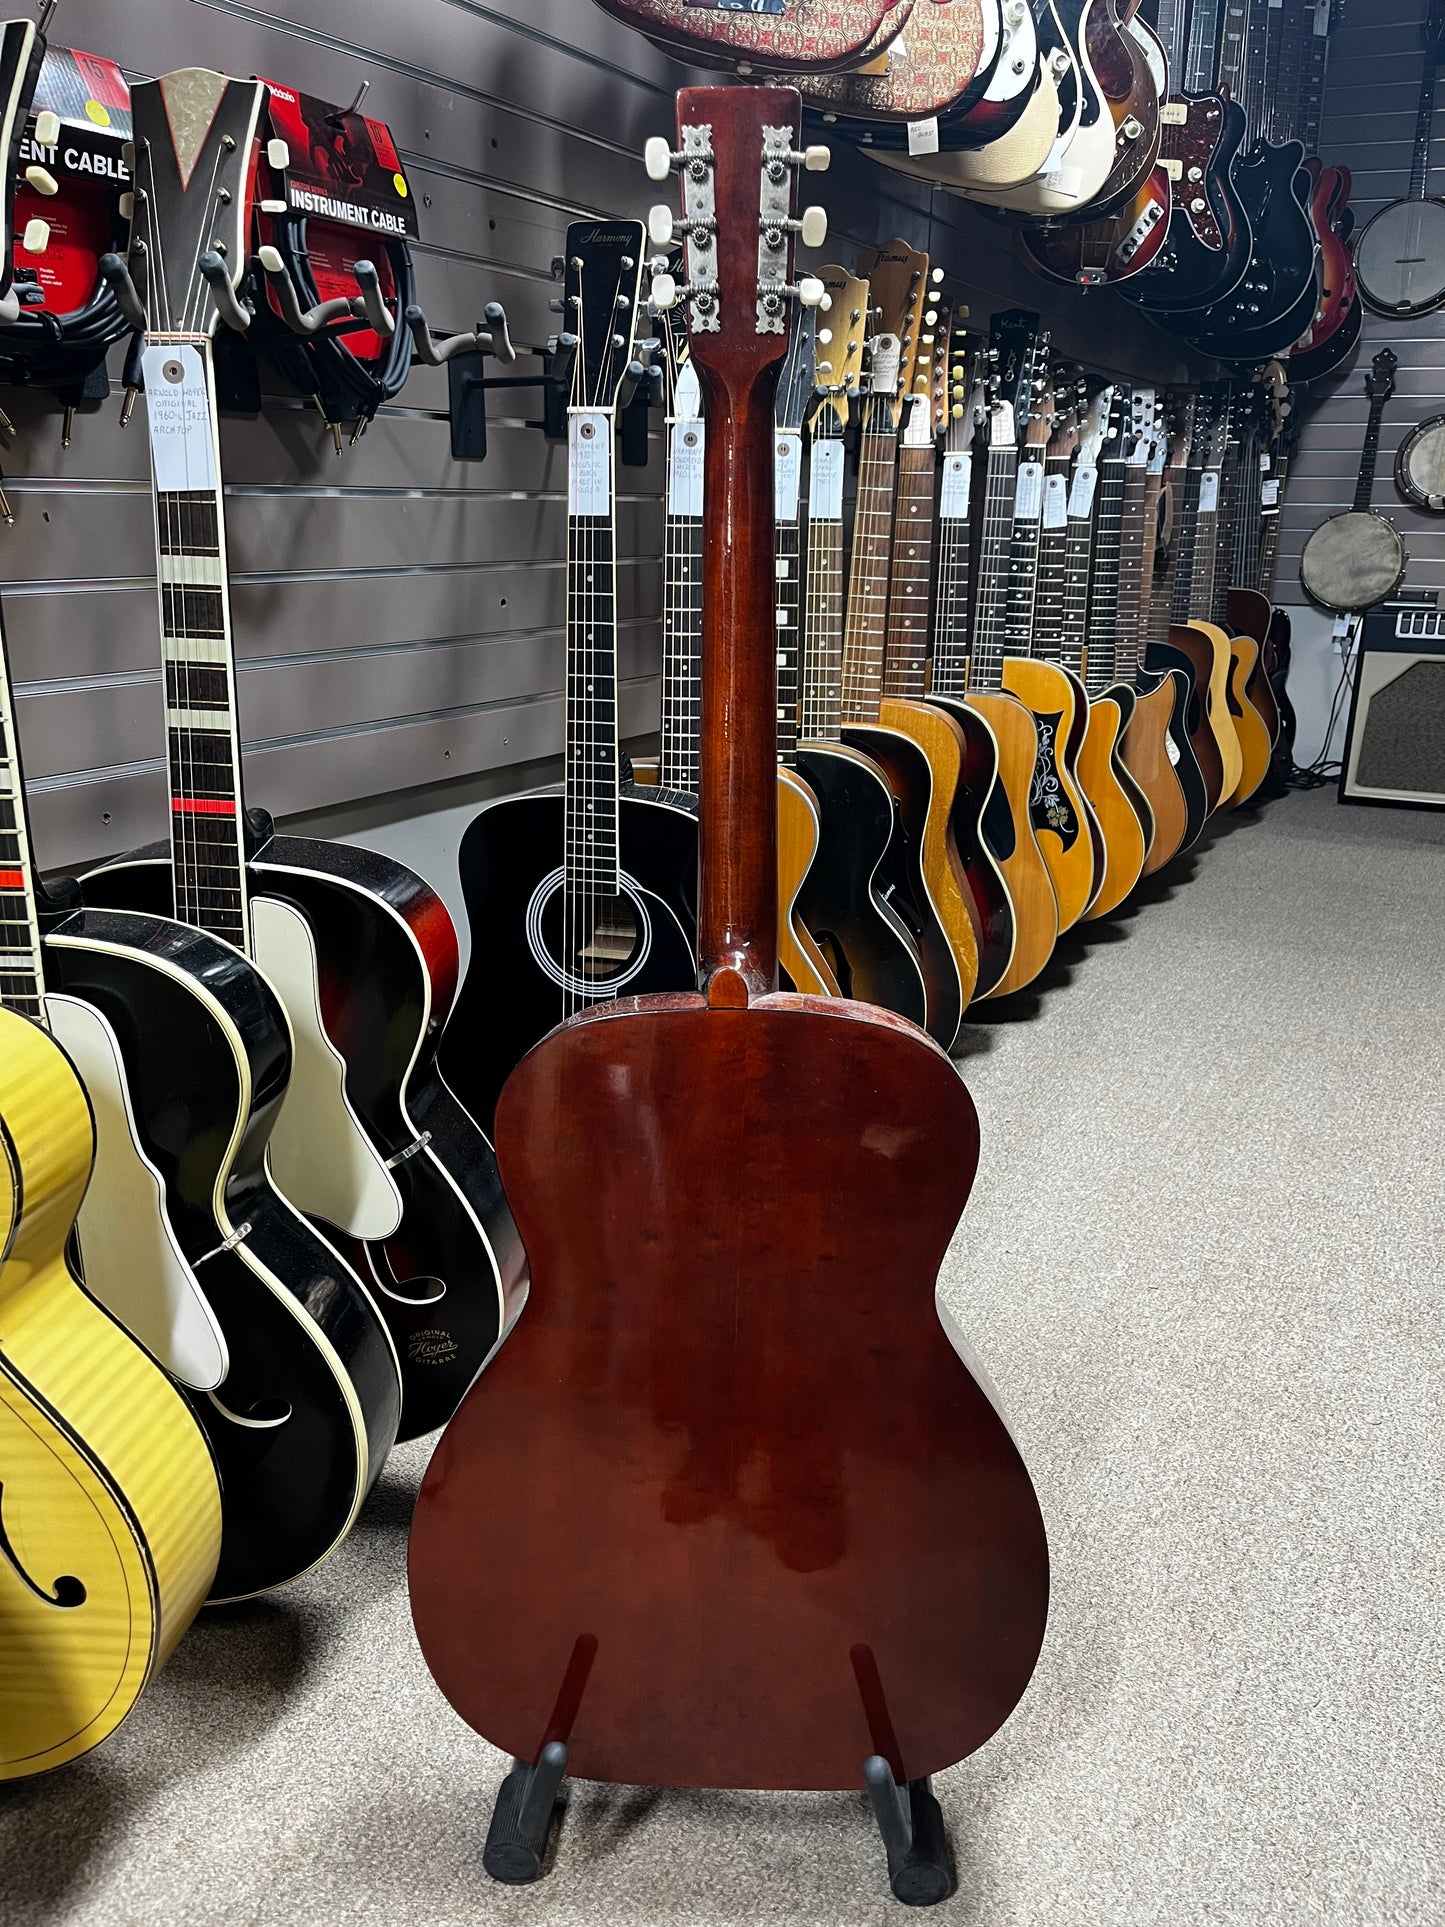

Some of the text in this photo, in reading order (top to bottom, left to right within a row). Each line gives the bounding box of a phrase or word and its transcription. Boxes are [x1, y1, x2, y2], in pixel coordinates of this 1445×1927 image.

[63, 147, 131, 182] CABLE
[290, 188, 407, 235] INSTRUMENT CABLE
[580, 228, 633, 247] Harmony
[873, 250, 911, 269] Framus
[409, 1329, 451, 1341] ORIGINAL
[408, 1340, 459, 1358] Hoyer
[415, 1353, 457, 1365] GITARRE
